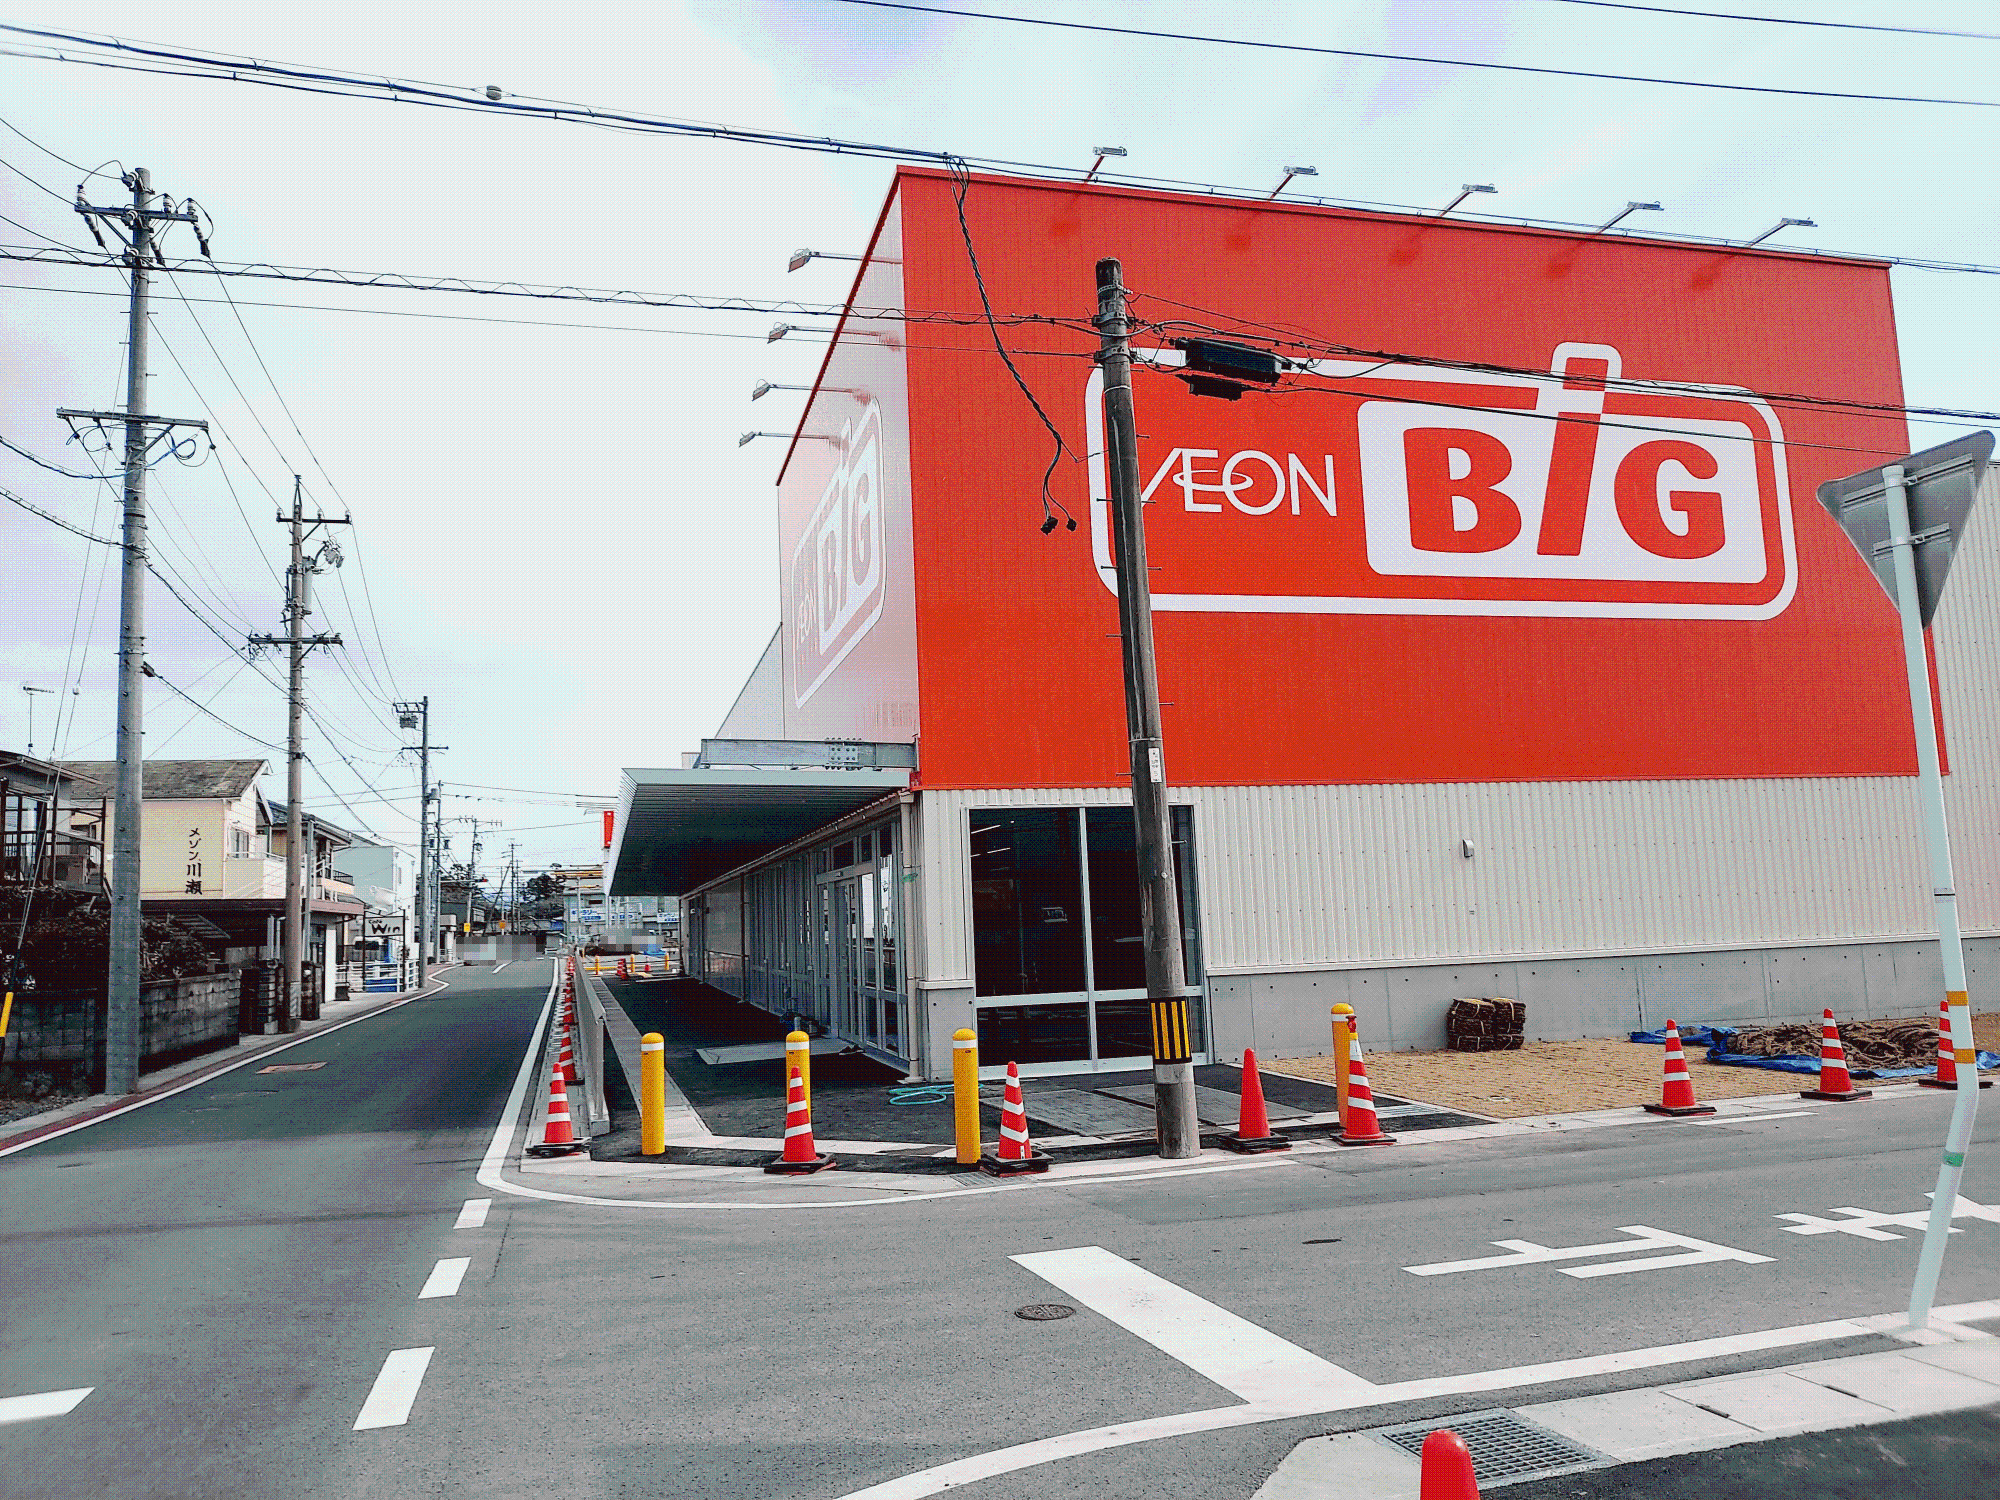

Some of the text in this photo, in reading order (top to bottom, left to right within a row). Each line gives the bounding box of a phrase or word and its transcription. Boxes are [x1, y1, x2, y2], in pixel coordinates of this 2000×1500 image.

[185, 827, 203, 896] メゾン川瀬
[371, 923, 401, 935] Win
